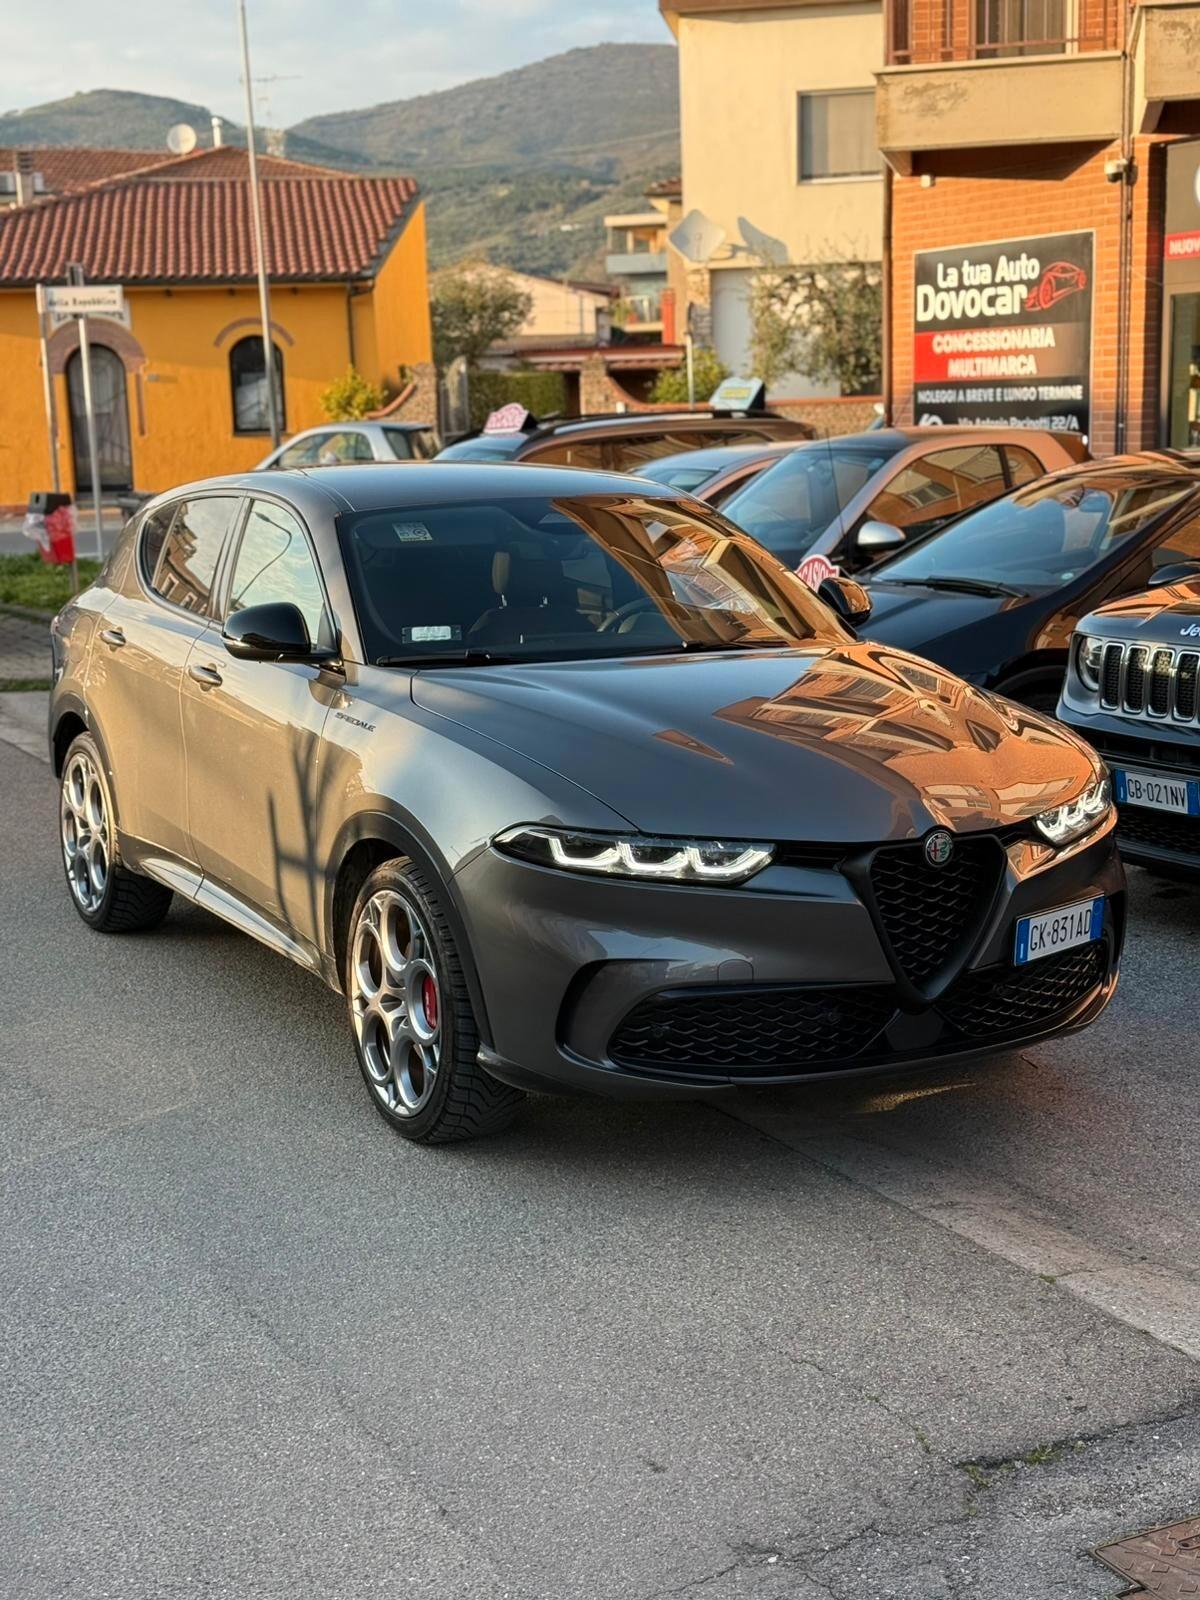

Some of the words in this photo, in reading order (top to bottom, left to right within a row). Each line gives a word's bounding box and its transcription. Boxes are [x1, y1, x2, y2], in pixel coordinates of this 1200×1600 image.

[937, 262, 959, 288] La
[961, 259, 992, 286] tua
[995, 253, 1040, 283] Auto
[916, 284, 1028, 322] Dovocar
[932, 327, 1056, 354] CONCESSIONARIA
[947, 354, 1037, 378] MULTIMARCA
[917, 388, 957, 404] NOLEGGI
[958, 389, 966, 403] A
[966, 388, 994, 403] BREVE
[996, 387, 1002, 402] E
[1004, 386, 1037, 402] LUNGO
[1038, 385, 1083, 400] TERMINE
[1051, 414, 1080, 430] 22/A
[1180, 623, 1200, 637] Je
